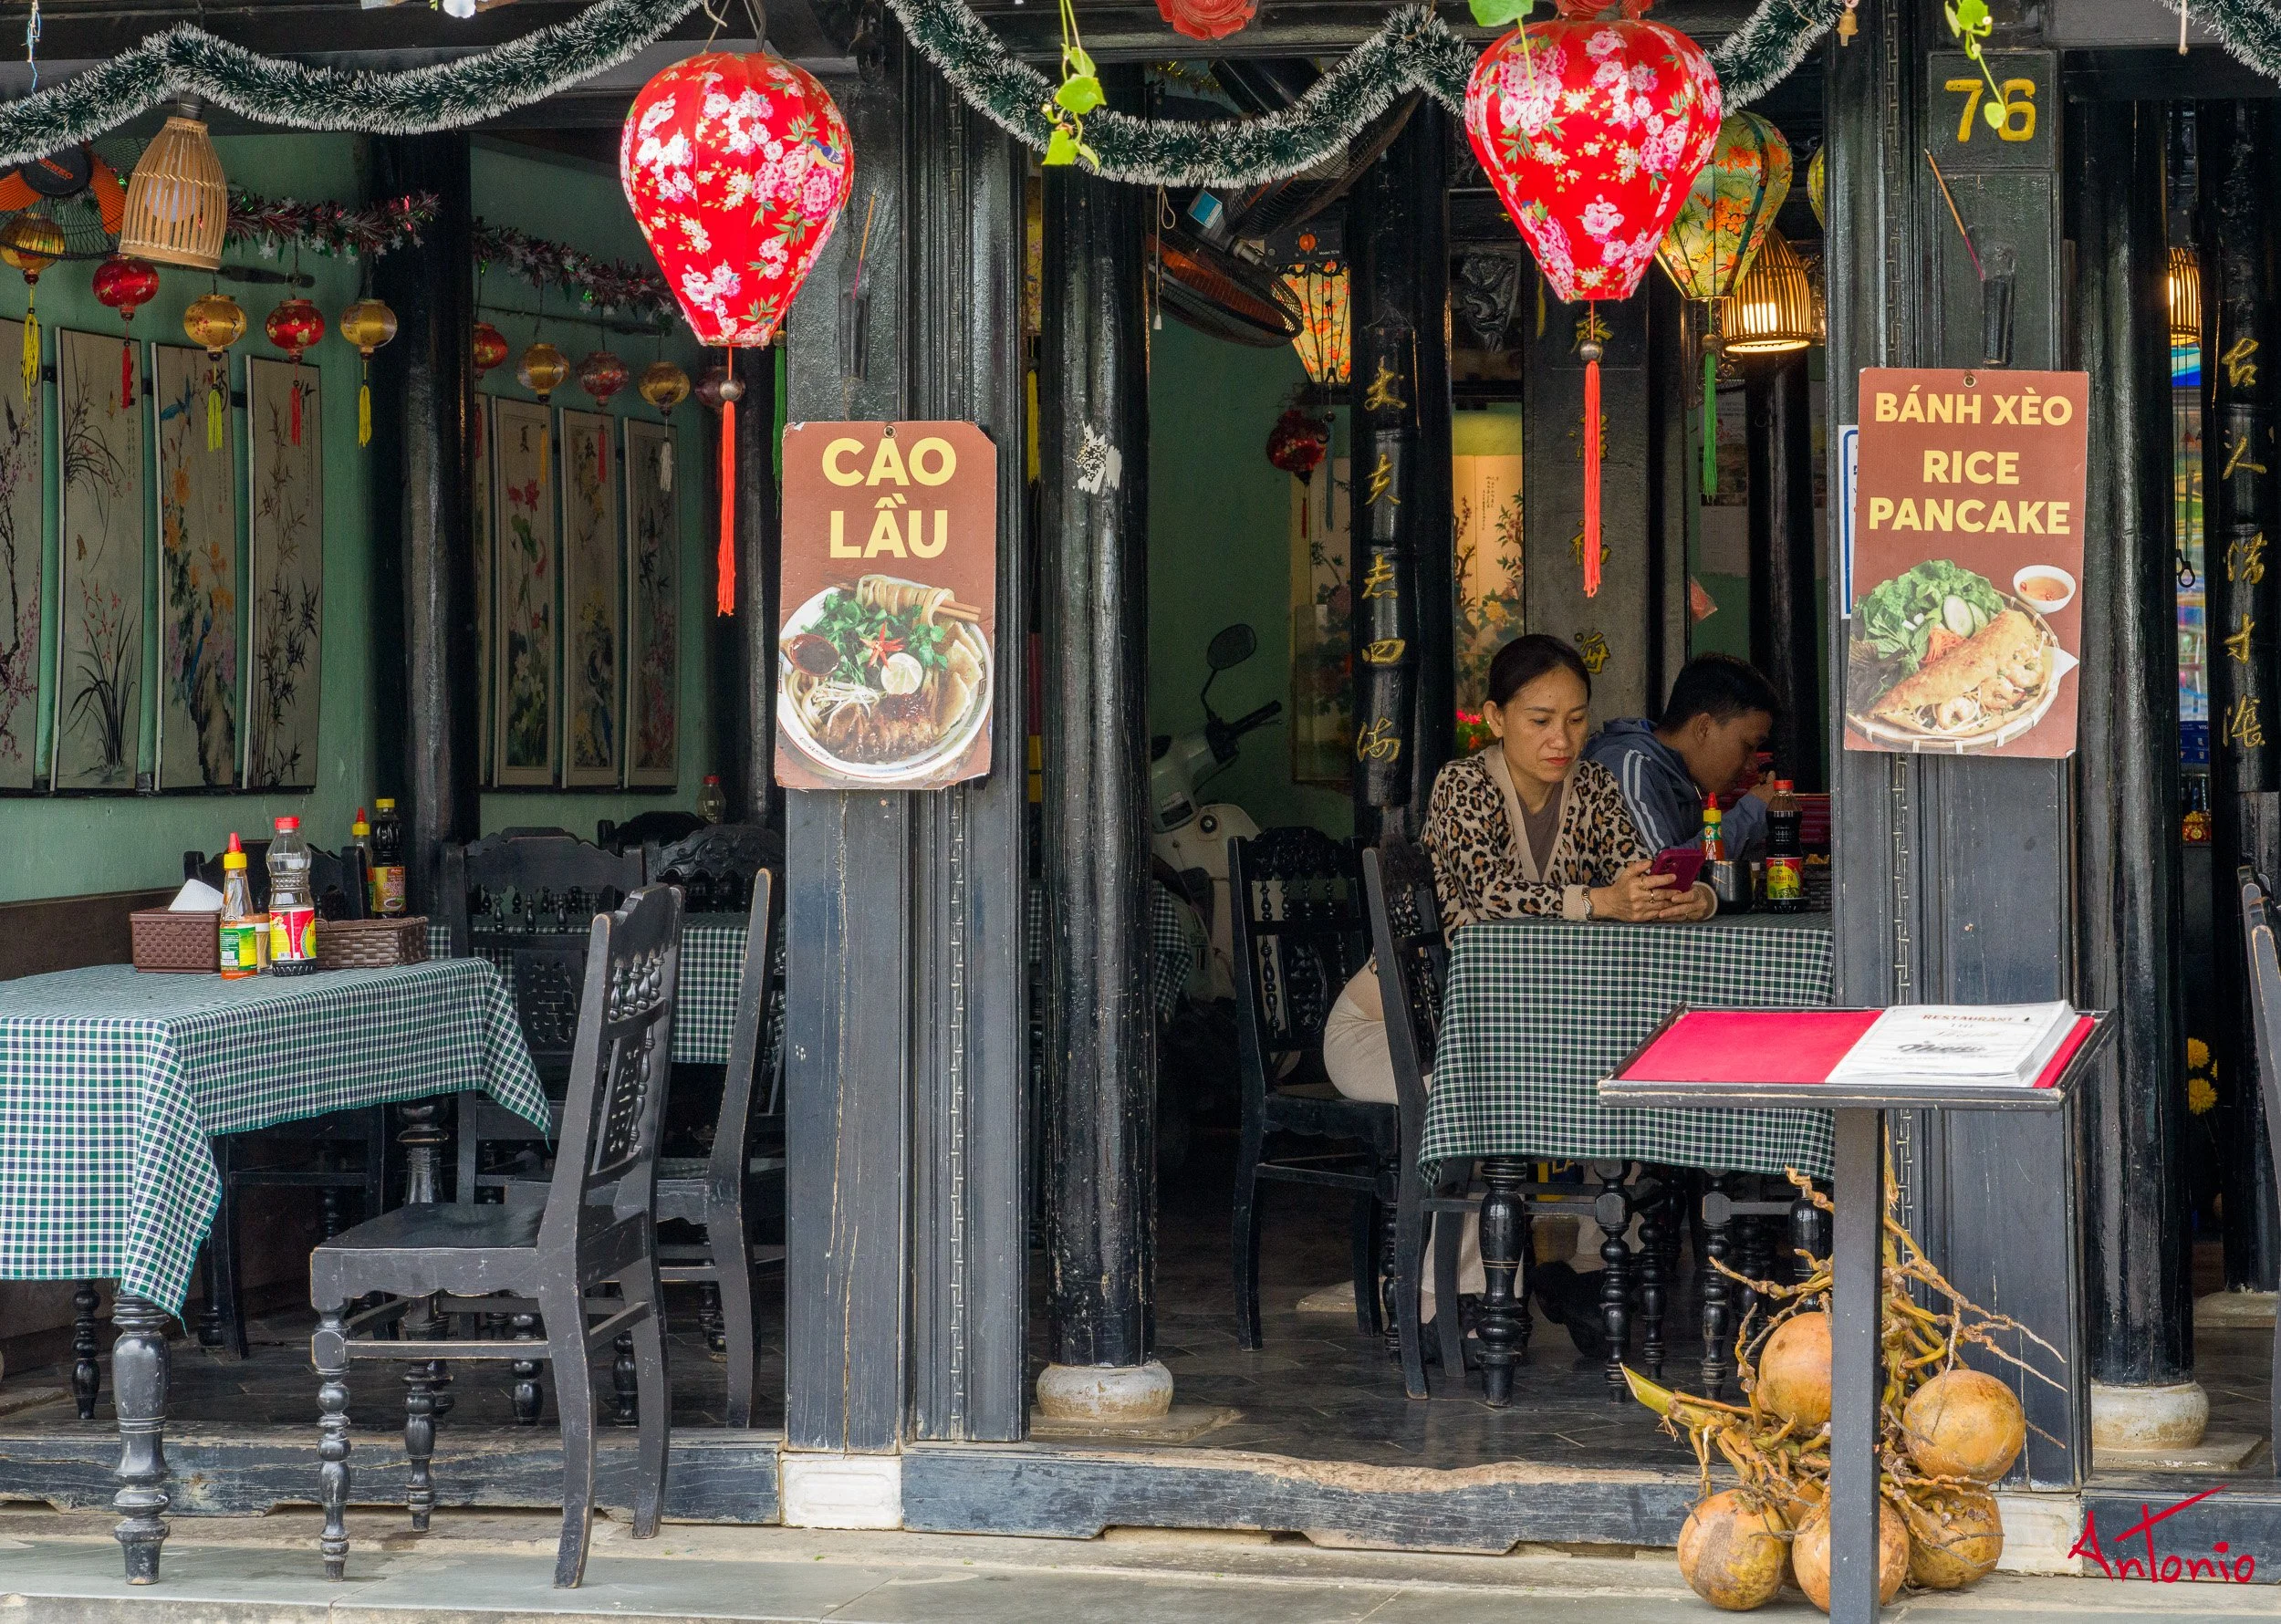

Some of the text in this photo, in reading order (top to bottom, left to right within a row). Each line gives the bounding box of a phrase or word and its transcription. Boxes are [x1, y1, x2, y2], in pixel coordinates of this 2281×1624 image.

[1944, 78, 2036, 142] 76
[1875, 384, 2073, 426] BÁNH XÈO
[822, 437, 957, 487] CAO
[1922, 450, 2020, 485] RICE
[829, 493, 948, 558] LẦU
[1869, 496, 2070, 535] PANCAKE
[1922, 1014, 2014, 1023] RESTAURANT
